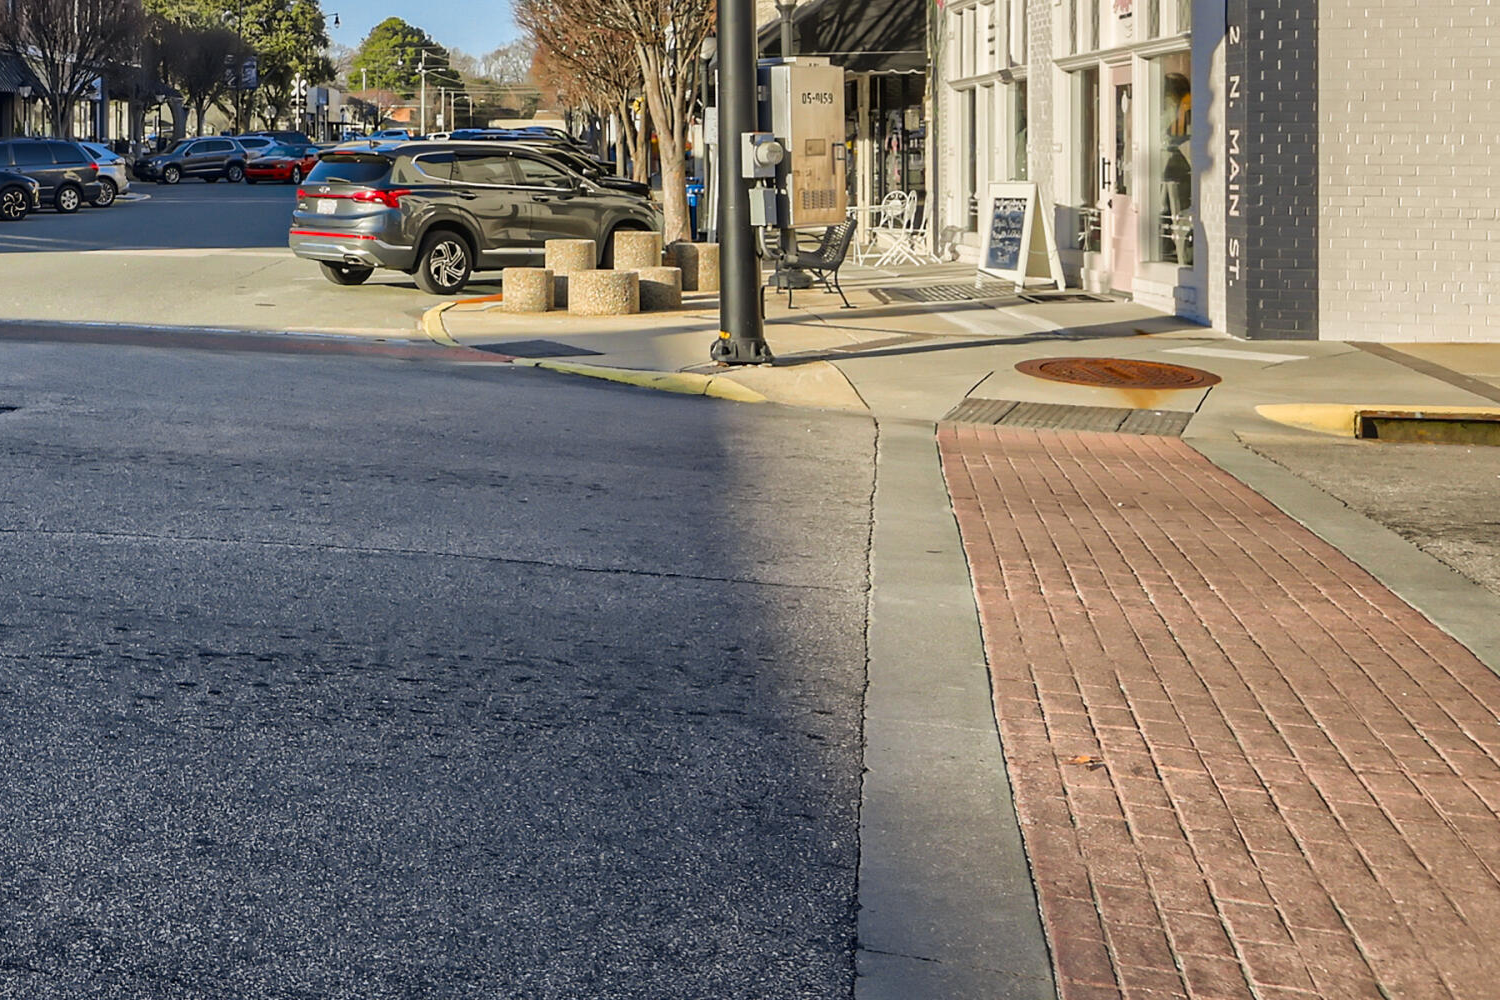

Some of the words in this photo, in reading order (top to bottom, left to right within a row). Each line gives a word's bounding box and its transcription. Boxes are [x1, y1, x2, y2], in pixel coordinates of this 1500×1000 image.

[1229, 26, 1240, 45] 2
[1229, 75, 1240, 108] N.
[1229, 129, 1240, 217] MAIN
[1229, 238, 1240, 287] ST.
